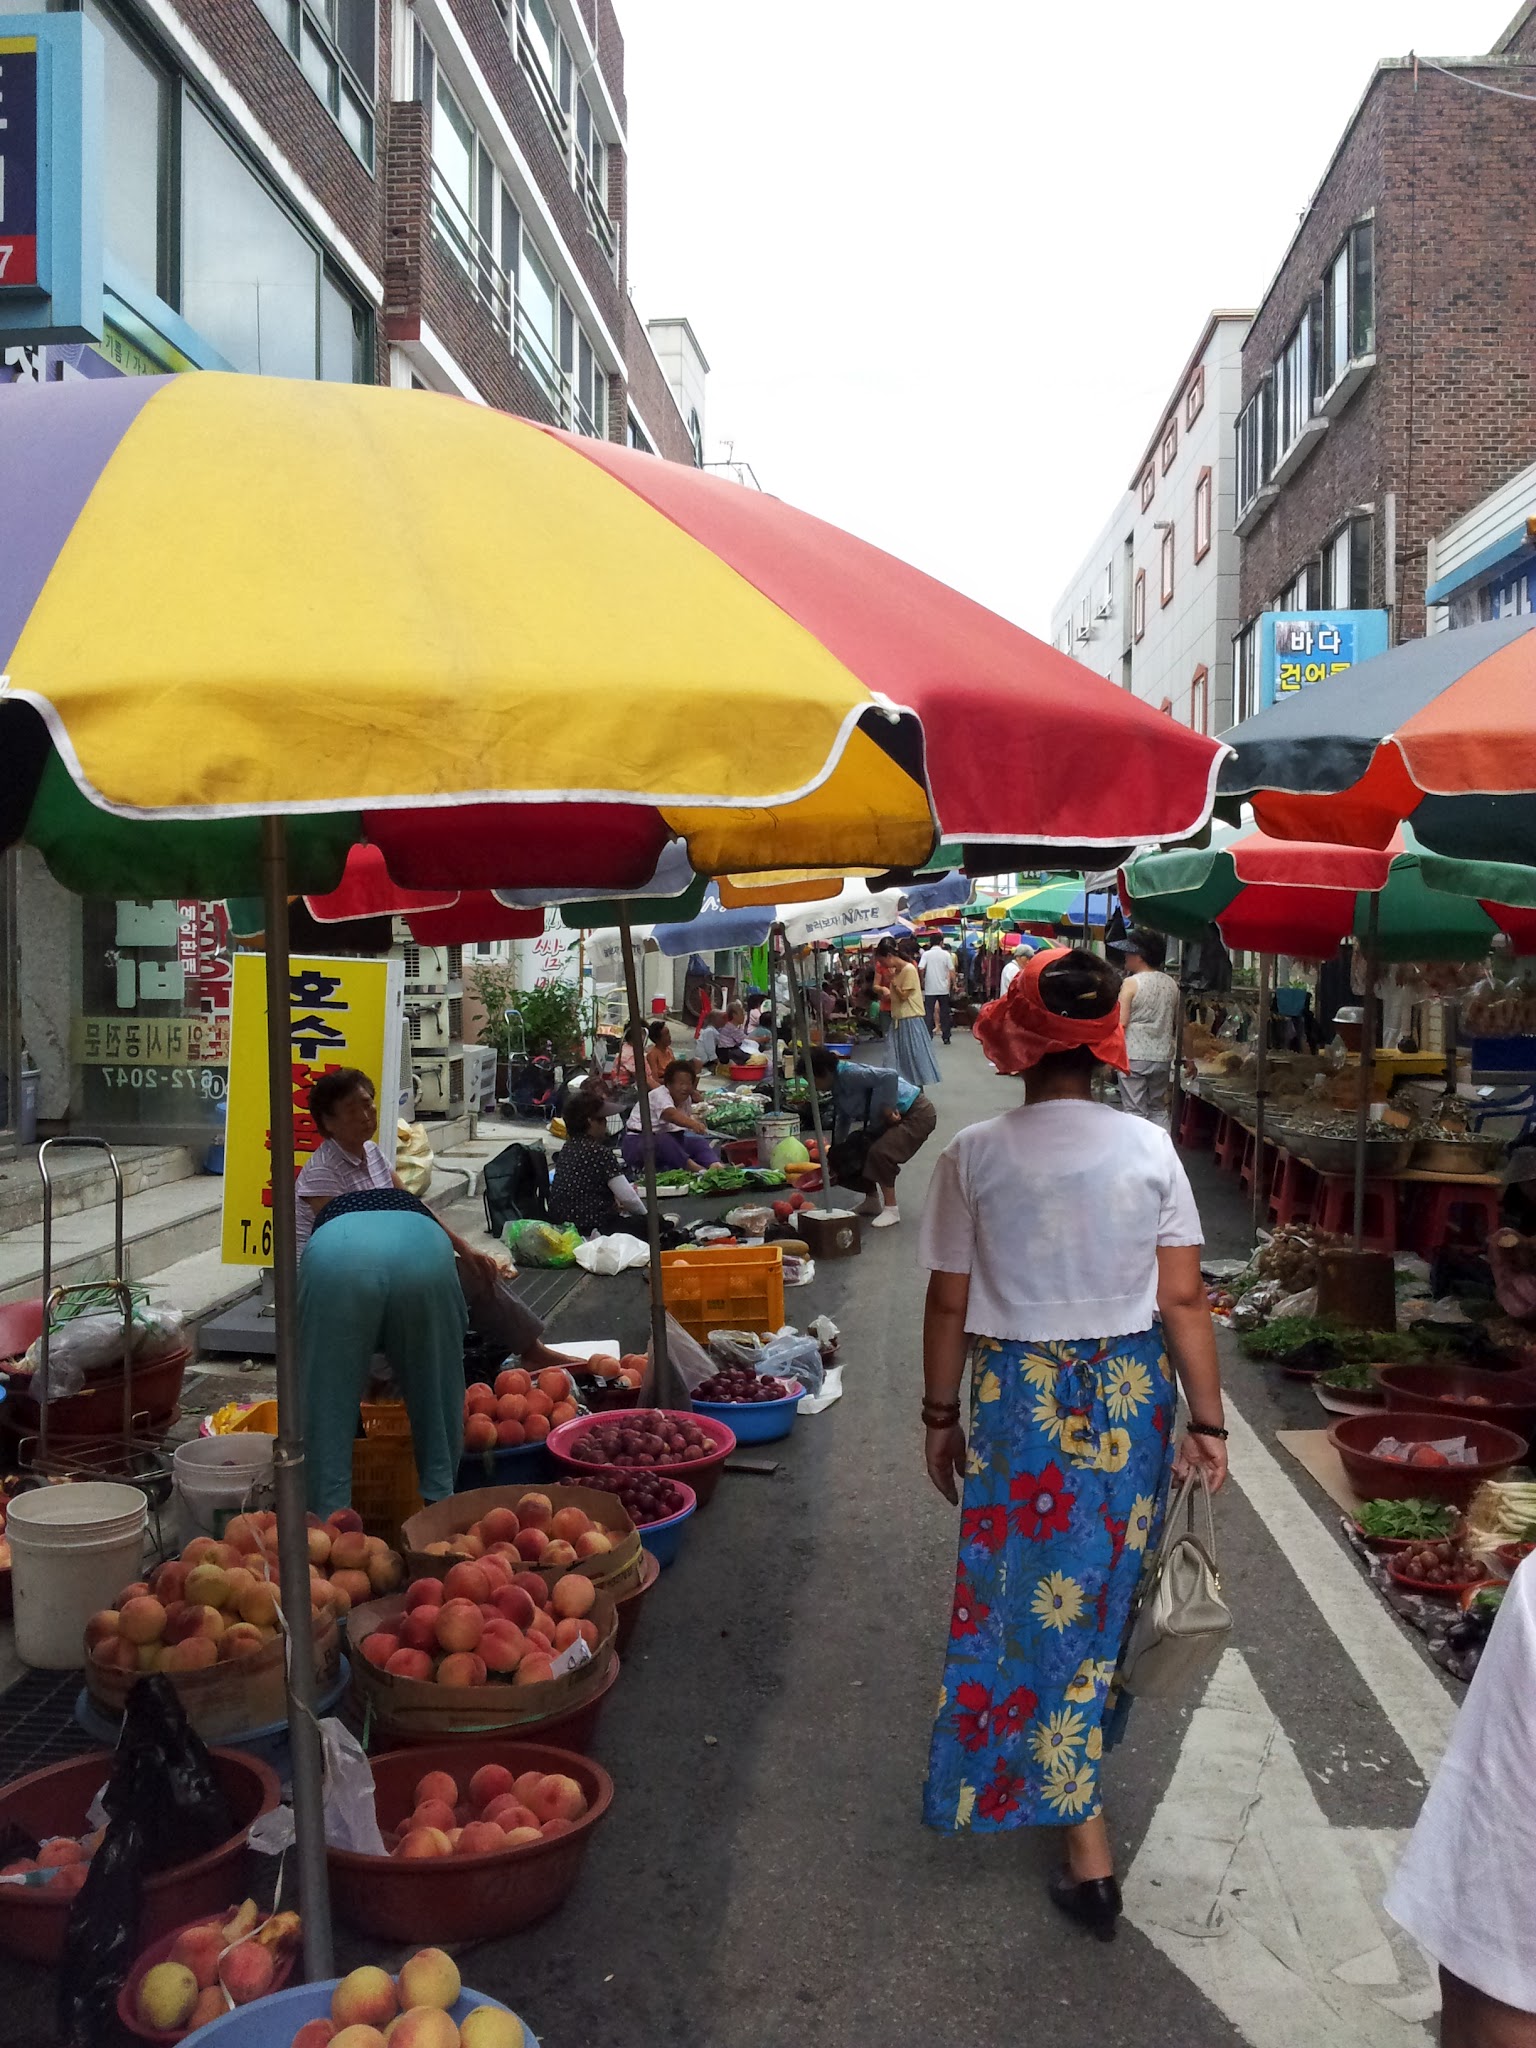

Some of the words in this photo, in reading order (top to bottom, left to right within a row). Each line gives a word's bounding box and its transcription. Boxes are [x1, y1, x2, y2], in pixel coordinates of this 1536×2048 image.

[106, 334, 122, 364] 기름
[1291, 630, 1342, 655] 바다
[842, 907, 880, 926] NATE
[179, 904, 198, 975] 예약판매
